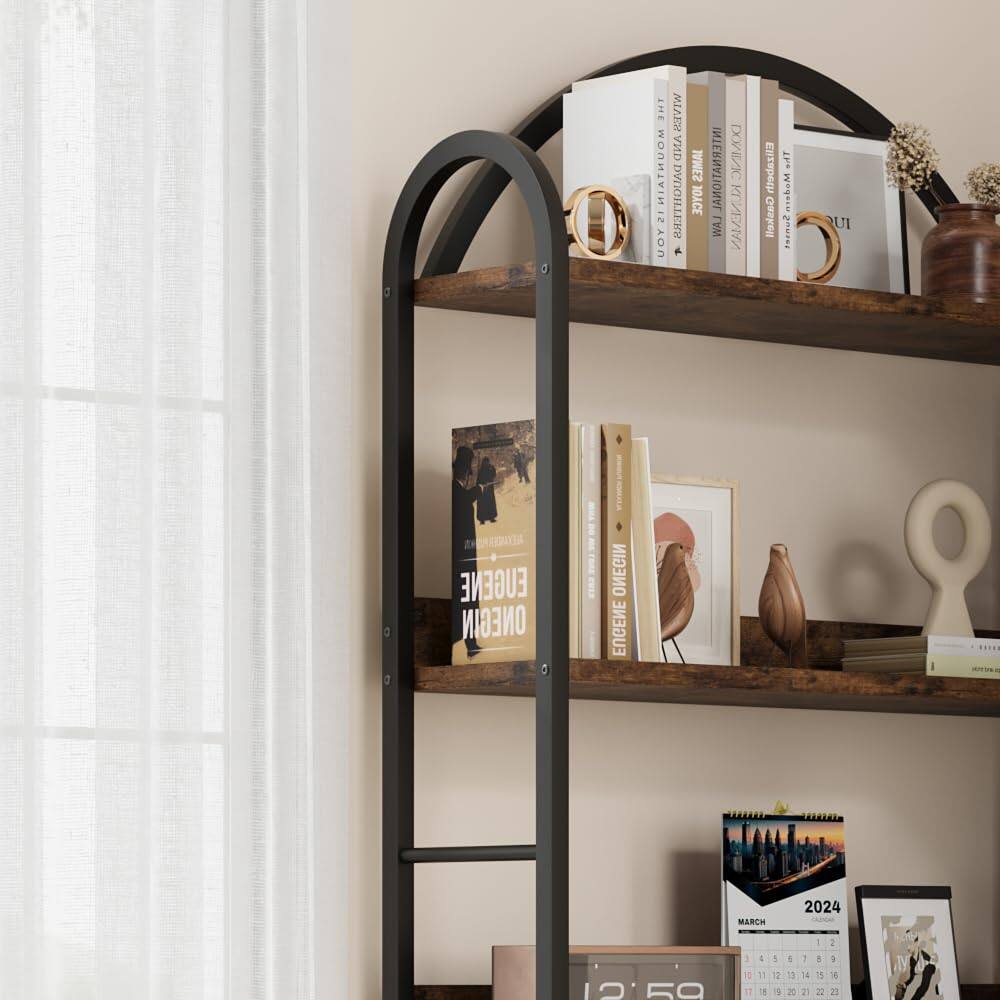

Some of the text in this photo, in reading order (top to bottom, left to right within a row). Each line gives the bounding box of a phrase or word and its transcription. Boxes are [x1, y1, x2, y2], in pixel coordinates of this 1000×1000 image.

[804, 900, 841, 914] 2024
[737, 918, 766, 926] MARCH
[816, 938, 836, 947] 1 2
[759, 955, 764, 963] 4
[772, 955, 778, 963] 5
[787, 955, 793, 963] 6
[802, 955, 808, 963] 7
[816, 955, 822, 963] 8
[831, 955, 836, 963] 9
[743, 971, 839, 980] 10 11 12 13 14 15 16
[744, 987, 839, 997] 17 18 19 20 21 22 23
